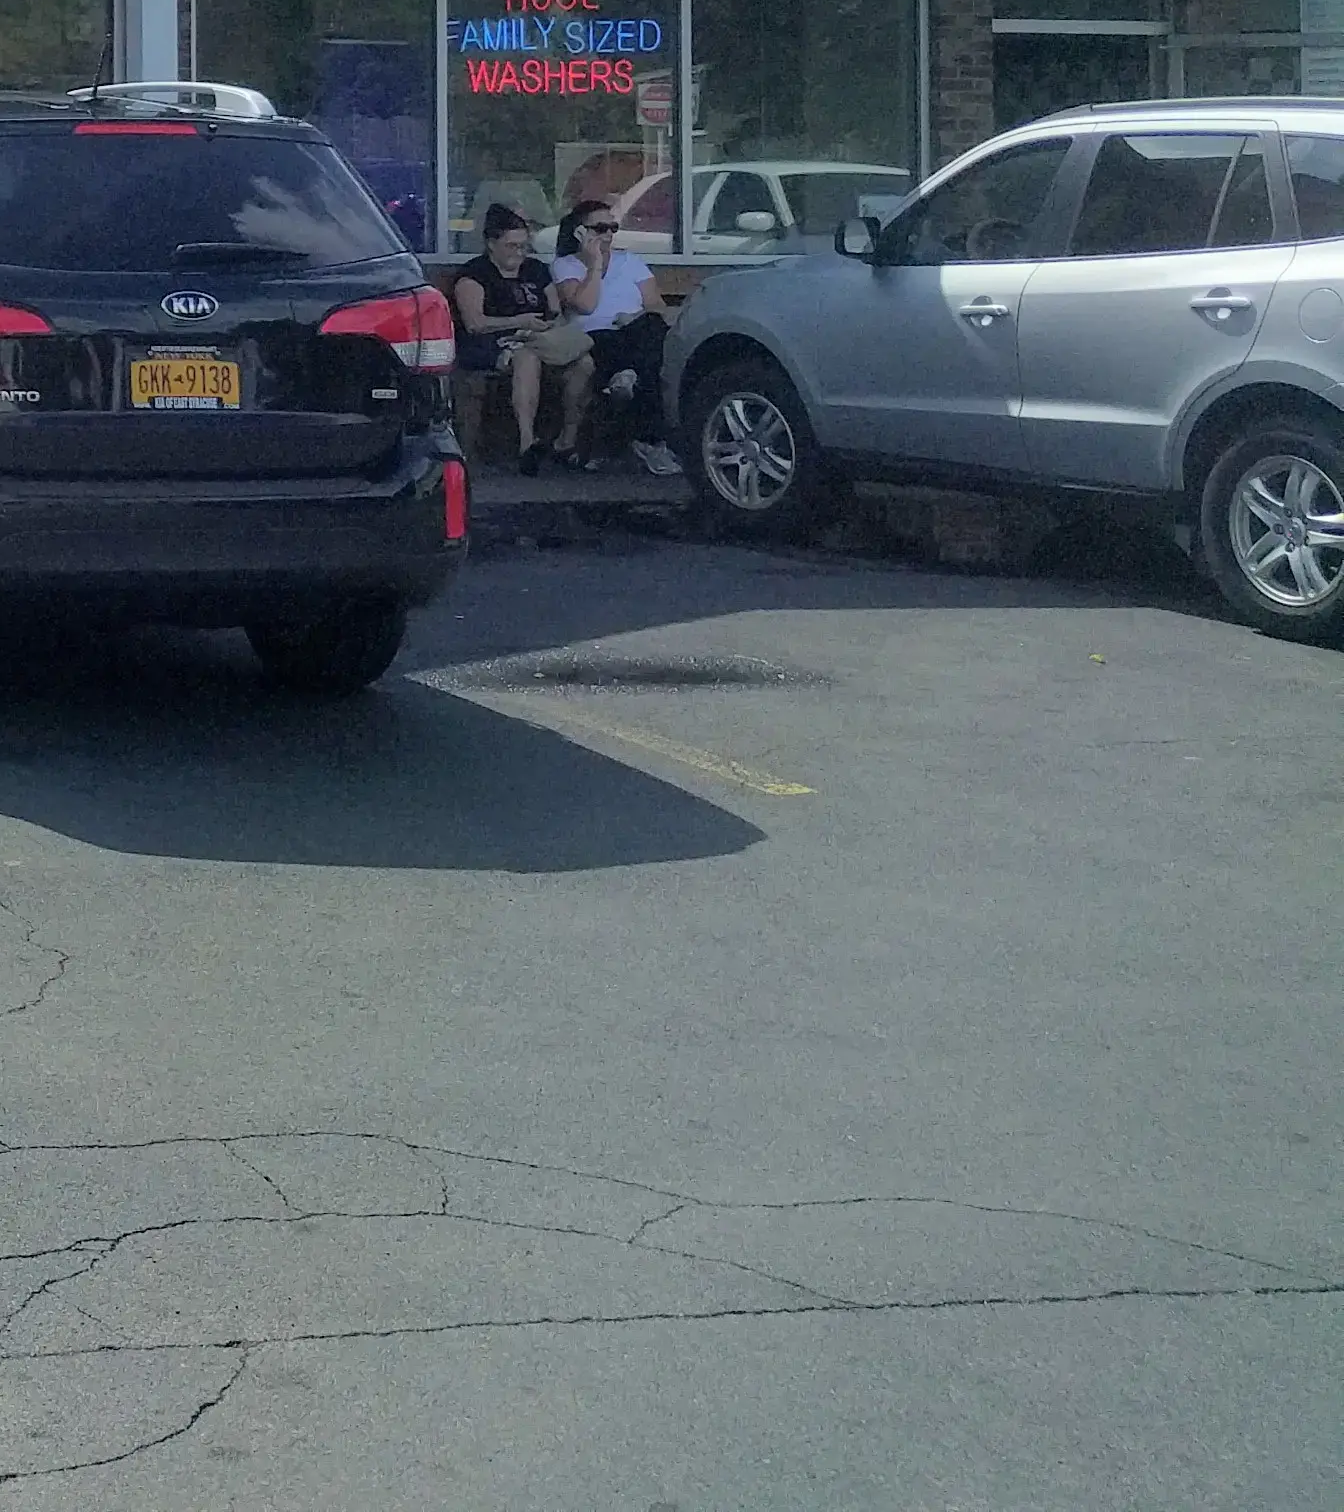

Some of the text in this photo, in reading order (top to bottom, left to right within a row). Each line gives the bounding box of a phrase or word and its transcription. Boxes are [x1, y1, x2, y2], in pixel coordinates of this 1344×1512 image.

[563, 19, 662, 54] SIZED
[466, 59, 635, 95] WASHERS
[170, 297, 211, 314] KIA
